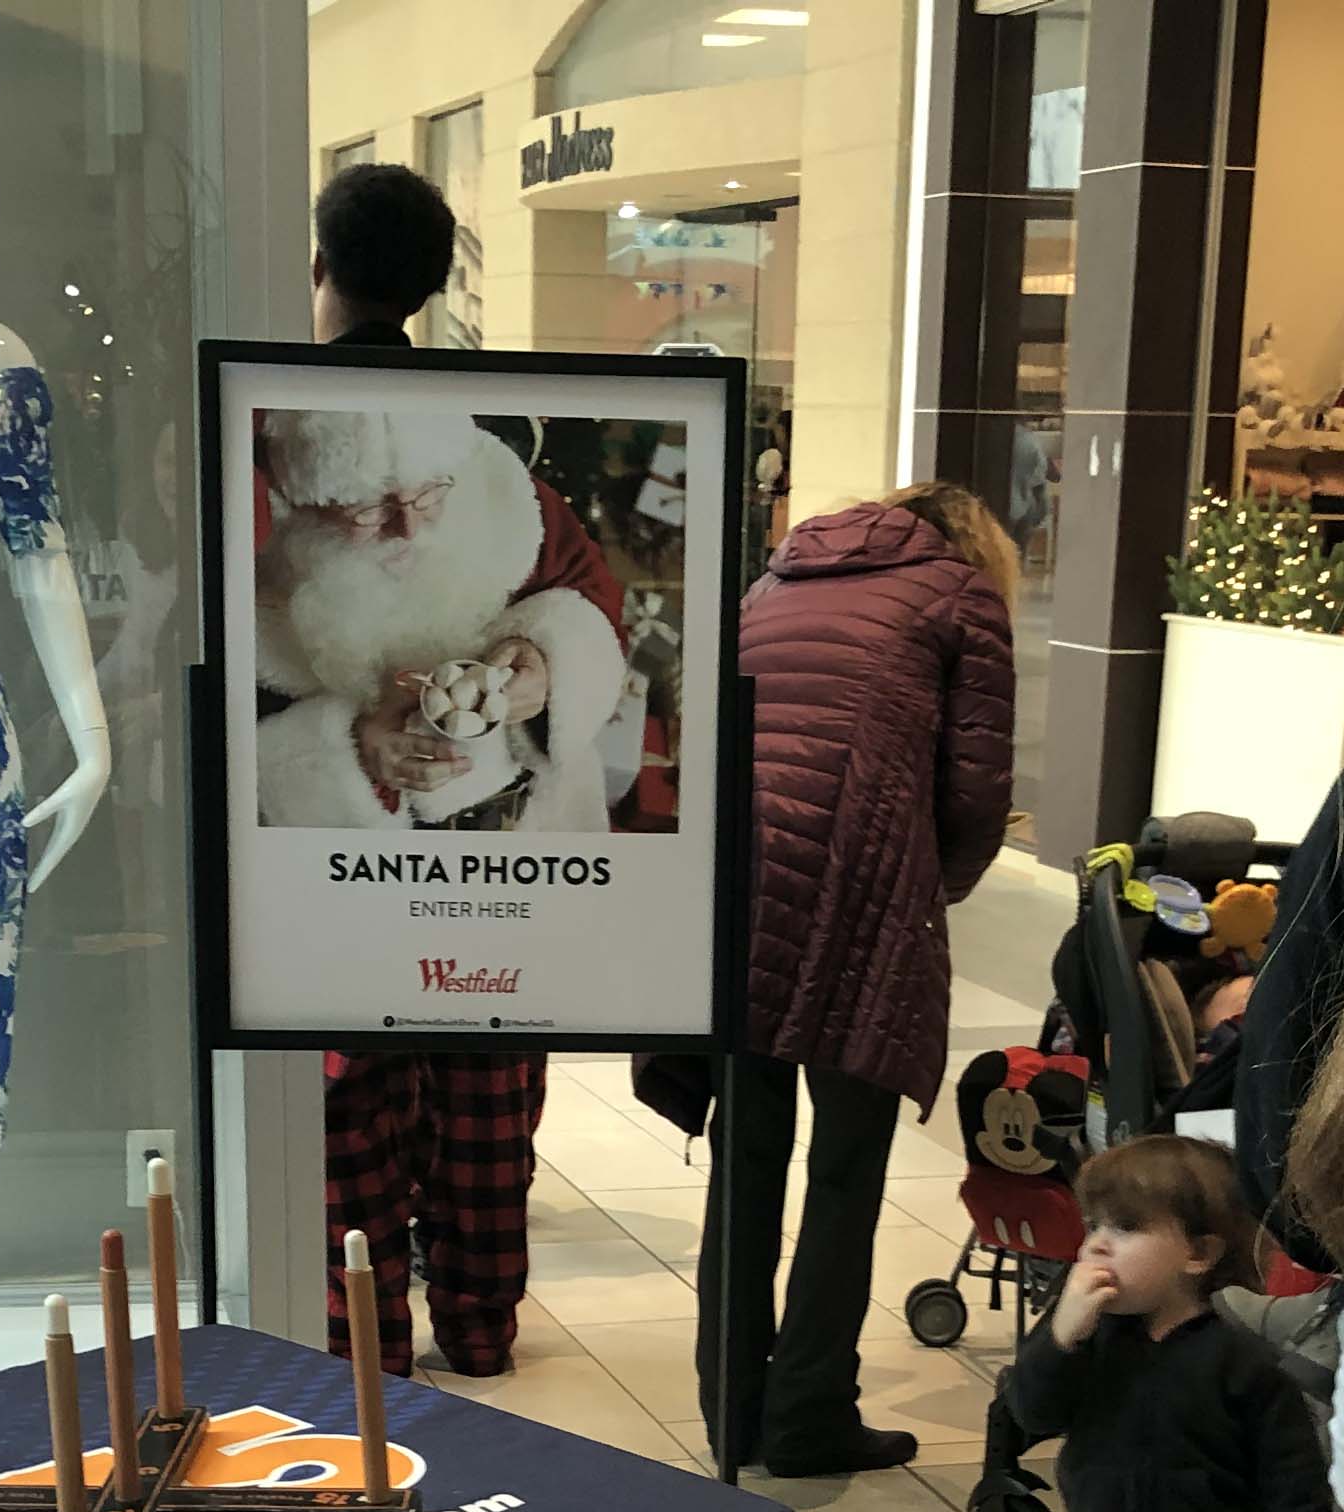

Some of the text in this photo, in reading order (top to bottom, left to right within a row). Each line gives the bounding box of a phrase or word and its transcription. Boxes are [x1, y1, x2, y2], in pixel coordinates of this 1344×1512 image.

[329, 853, 611, 886] SANTA PHOTOS
[409, 901, 532, 919] ENTER HERE
[418, 957, 523, 994] Westfield
